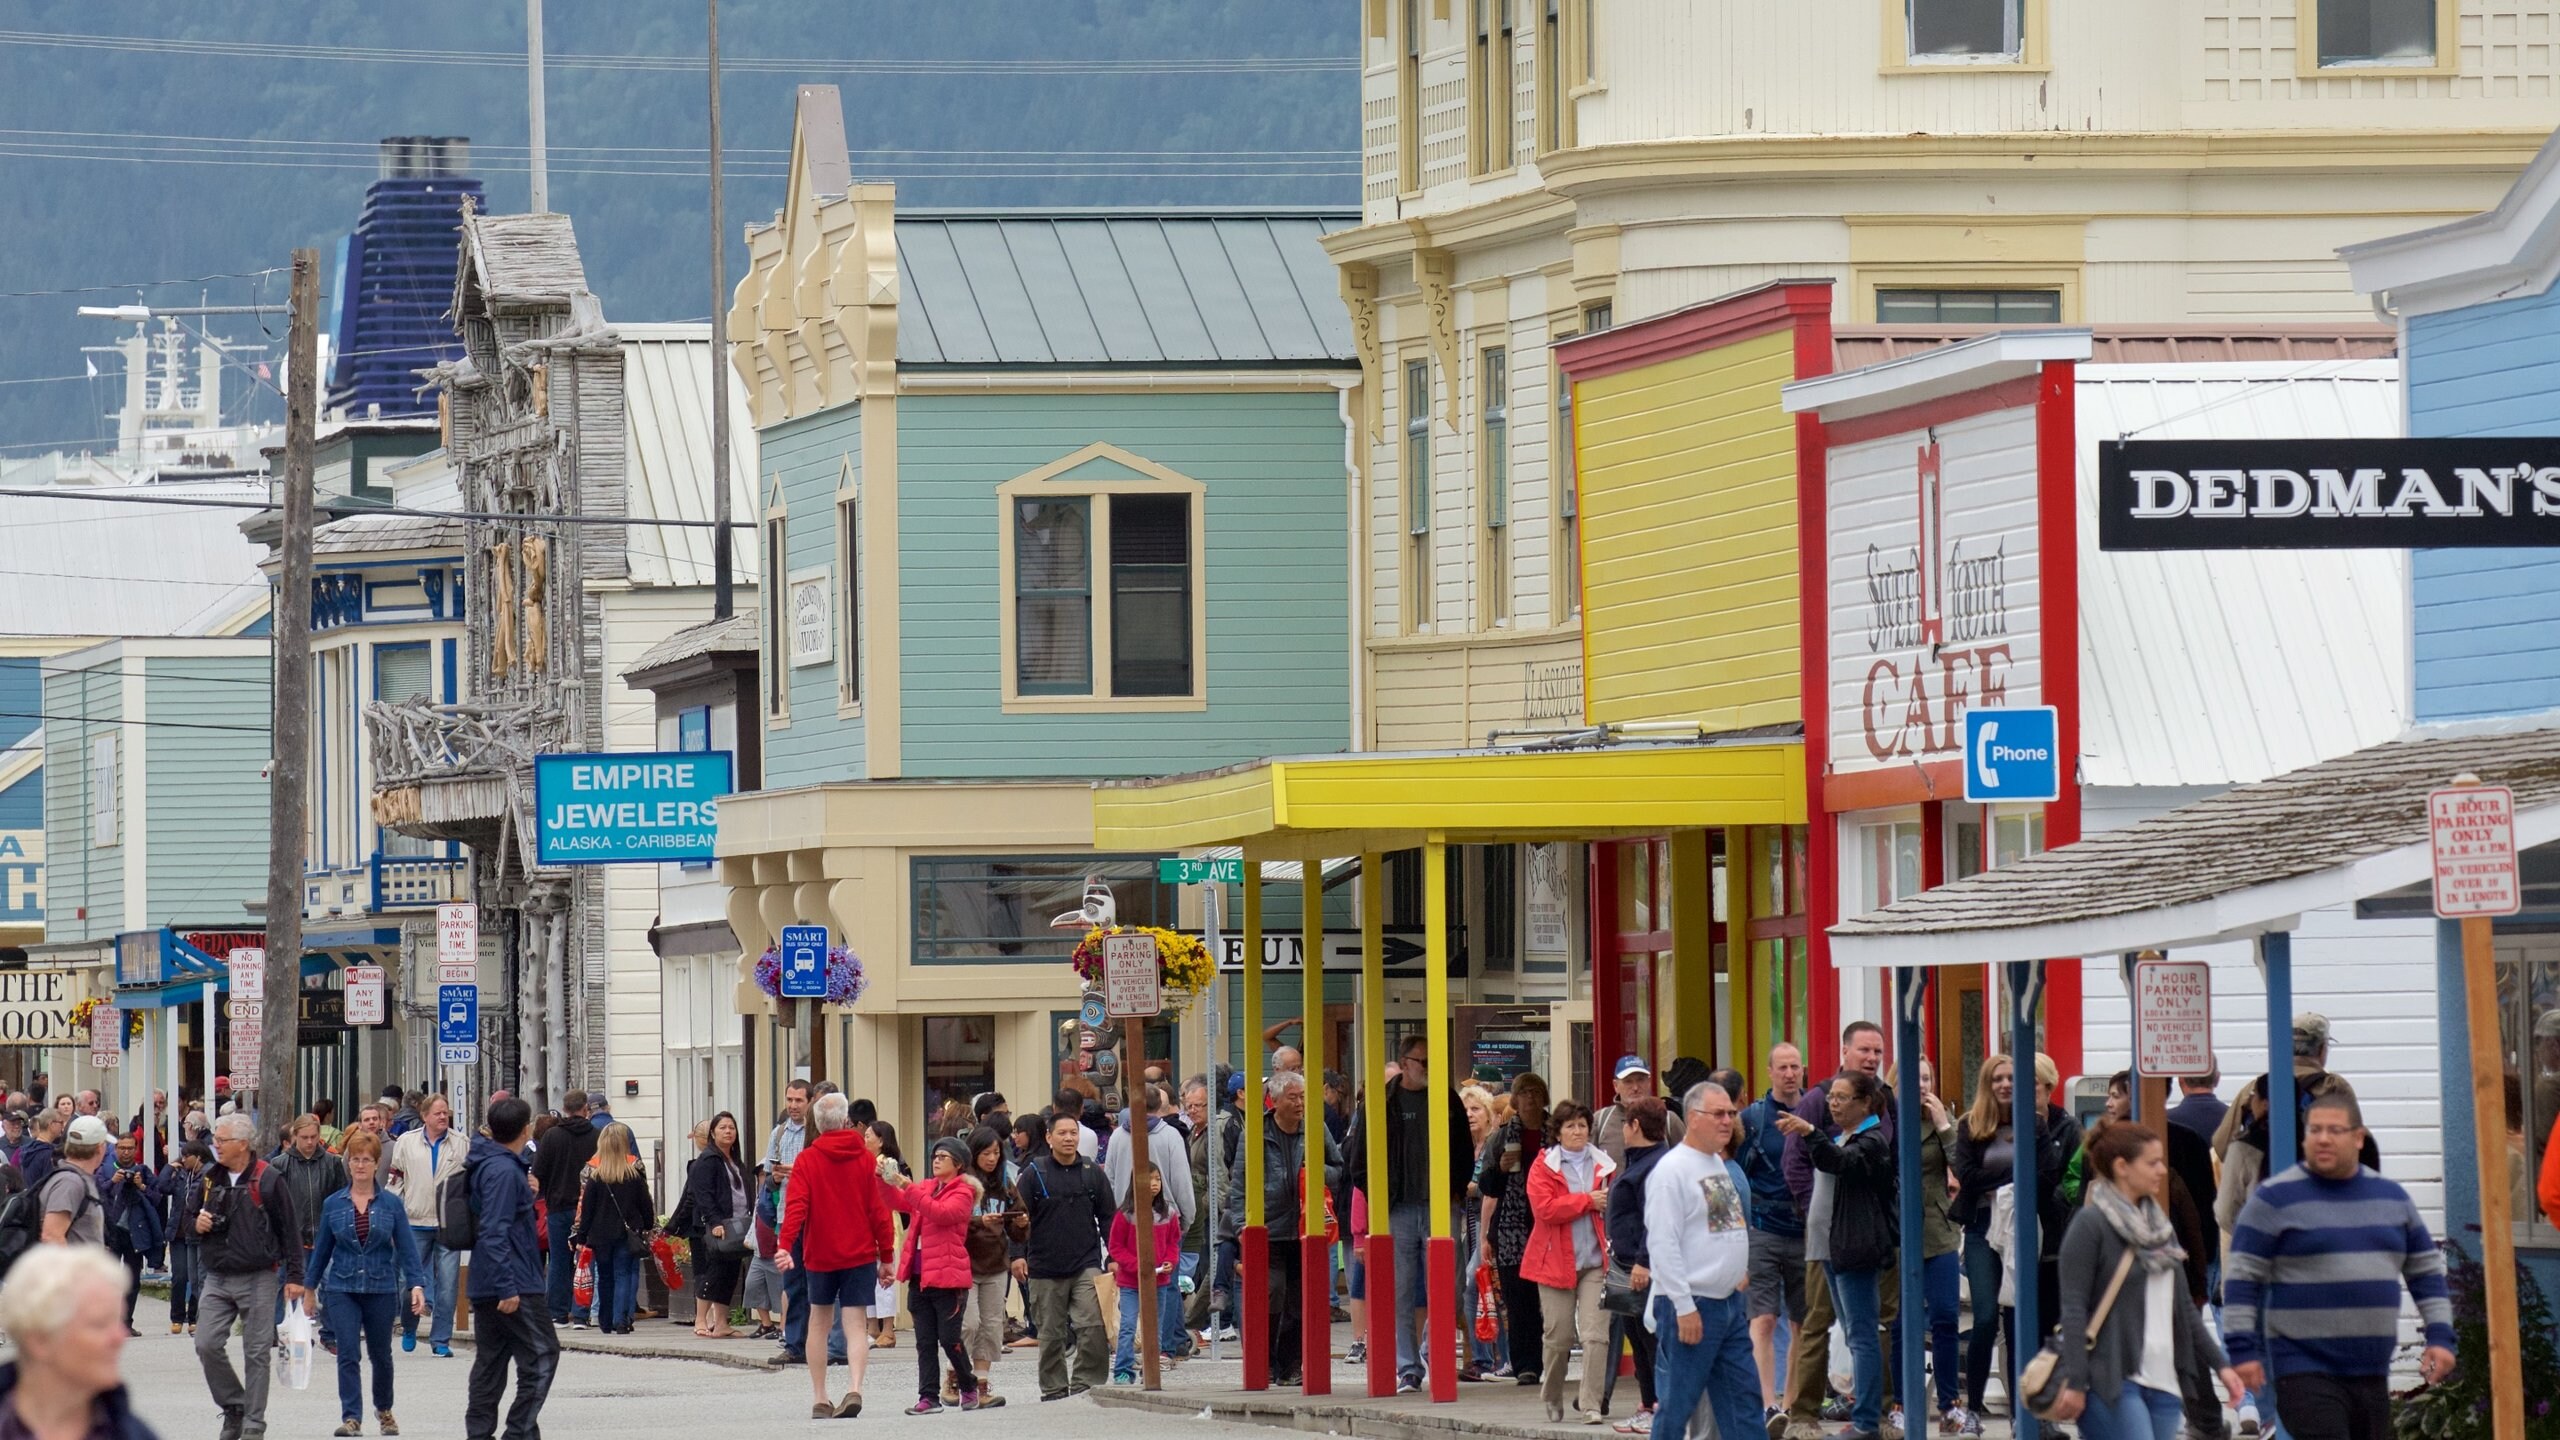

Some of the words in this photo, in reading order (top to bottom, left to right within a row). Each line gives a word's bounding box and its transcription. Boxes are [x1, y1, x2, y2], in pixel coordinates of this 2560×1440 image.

[2129, 462, 2560, 518] DEDMAN'S
[1993, 746, 2048, 761] Phone
[572, 764, 695, 791] EMPIRE
[2442, 803, 2447, 814] 1
[2457, 801, 2500, 813] HOUR
[547, 801, 718, 829] JEWELERS
[2435, 815, 2509, 828] PARKING
[2451, 829, 2493, 842] ONLY
[549, 836, 612, 850] ALASKA
[626, 834, 717, 848] CARIBBEAN
[1209, 862, 1237, 879] AVE
[2440, 866, 2454, 876] NO
[2460, 863, 2513, 874] VEHICLES
[2453, 878, 2483, 889] OVER
[2447, 894, 2458, 903] IN
[2465, 891, 2508, 902] LENGTH
[451, 911, 463, 919] NO
[441, 921, 473, 929] PARKING
[786, 933, 823, 941] SMART
[449, 941, 466, 949] TIME
[1111, 951, 1151, 960] PARKING
[1119, 960, 1143, 968] ONLY
[347, 971, 358, 982] NO
[2162, 973, 2197, 983] HOUR
[0, 973, 62, 1002] THE
[2146, 985, 2201, 995] PARKING
[442, 989, 475, 997] SMART
[2157, 998, 2190, 1008] ONLY
[235, 1006, 259, 1015] END
[0, 1010, 74, 1040] OOM
[2147, 1024, 2158, 1032] NO
[2162, 1023, 2203, 1032] VEHICLES
[2157, 1034, 2179, 1042] OVER
[2152, 1045, 2160, 1053] IN
[2166, 1044, 2197, 1053] LENGTH
[446, 1050, 471, 1059] END
[96, 1056, 118, 1064] END
[2144, 1056, 2158, 1064] MAY
